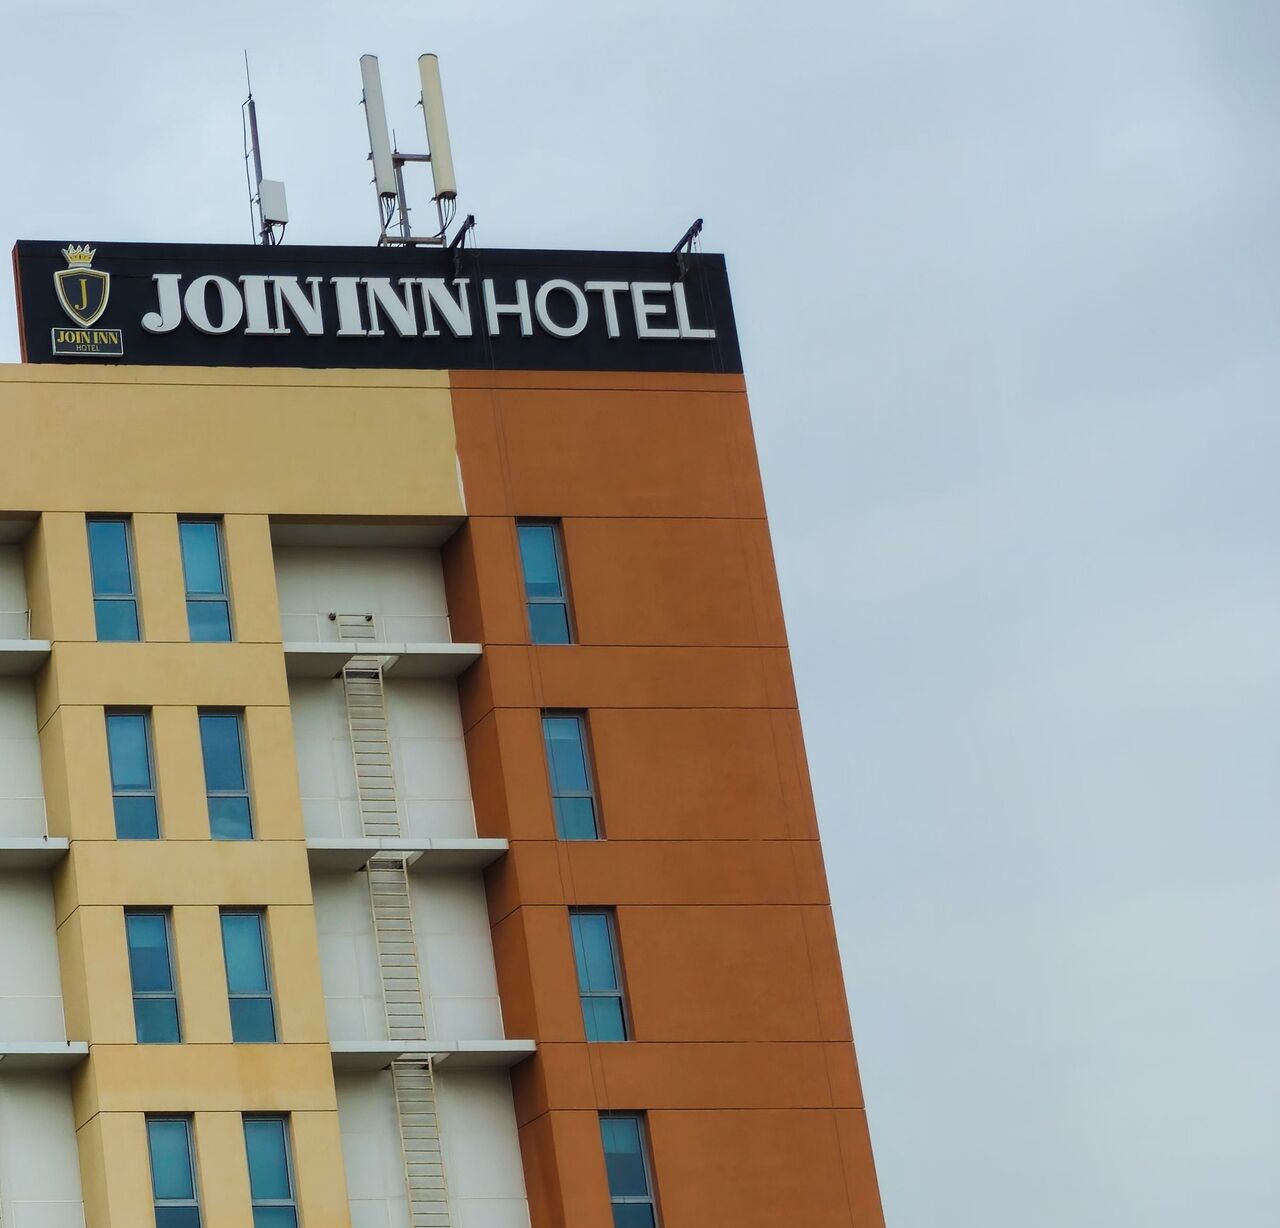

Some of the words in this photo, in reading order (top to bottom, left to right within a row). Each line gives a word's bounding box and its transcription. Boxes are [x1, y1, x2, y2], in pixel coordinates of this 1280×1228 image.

[74, 279, 87, 311] J
[141, 273, 324, 337] JOIN
[330, 275, 476, 340] INN
[484, 277, 717, 341] HOTEL
[57, 331, 90, 344] JOIN
[93, 331, 118, 344] INN
[76, 344, 100, 352] HOTEL
